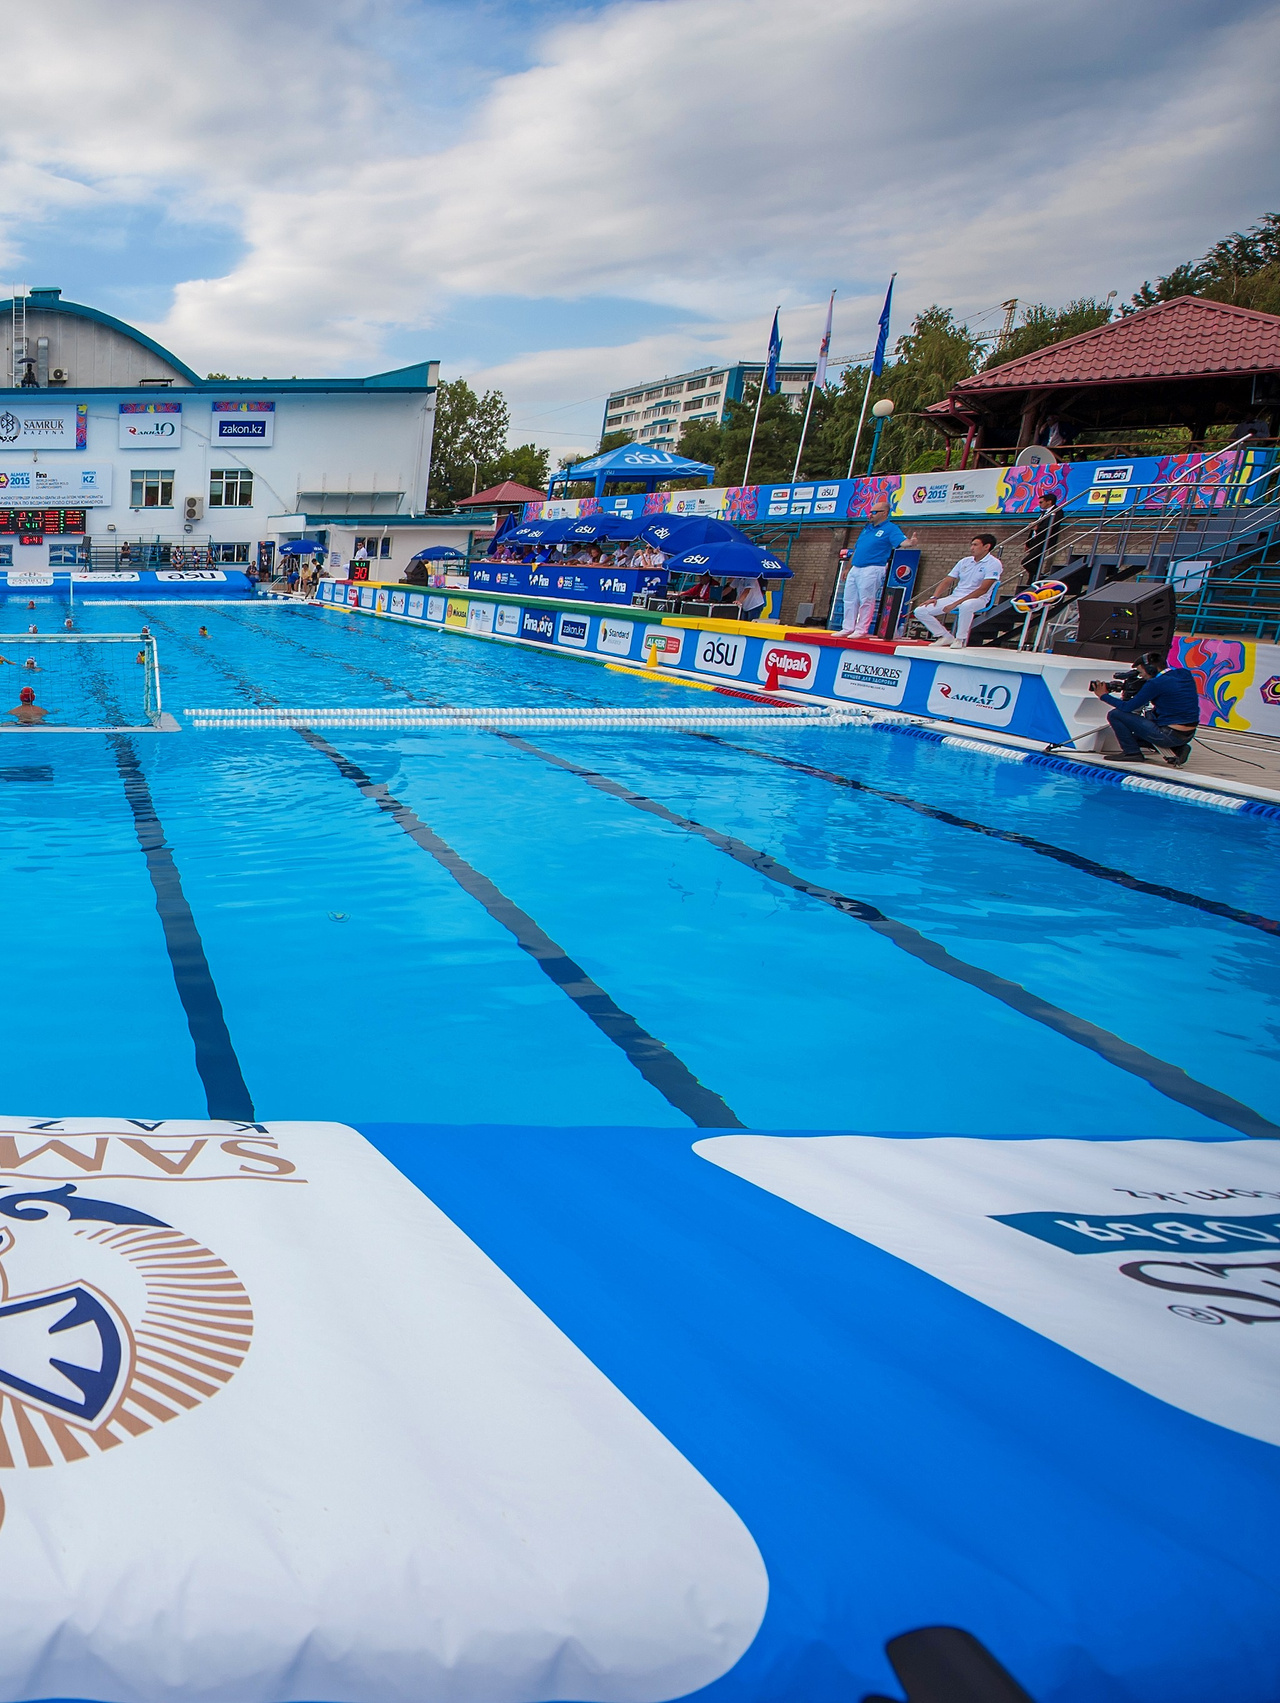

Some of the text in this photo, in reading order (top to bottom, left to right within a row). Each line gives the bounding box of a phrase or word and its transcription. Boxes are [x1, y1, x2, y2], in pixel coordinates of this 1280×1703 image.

[23, 420, 65, 429] SAMRUK
[222, 424, 262, 433] zakon.kz
[10, 477, 30, 485] 2015
[1098, 471, 1126, 480] Fina.org
[953, 483, 965, 491] Fina
[927, 490, 947, 499] 2015
[354, 567, 368, 579] 30
[613, 578, 627, 592] Fina
[523, 614, 553, 637] Fina.org
[563, 625, 584, 637] zakon.kz
[609, 628, 630, 639] Standard
[647, 638, 666, 648] ALSER
[767, 652, 808, 672] Sulpak
[843, 661, 900, 679] BLACKMORES
[937, 682, 994, 705] RAKHAT
